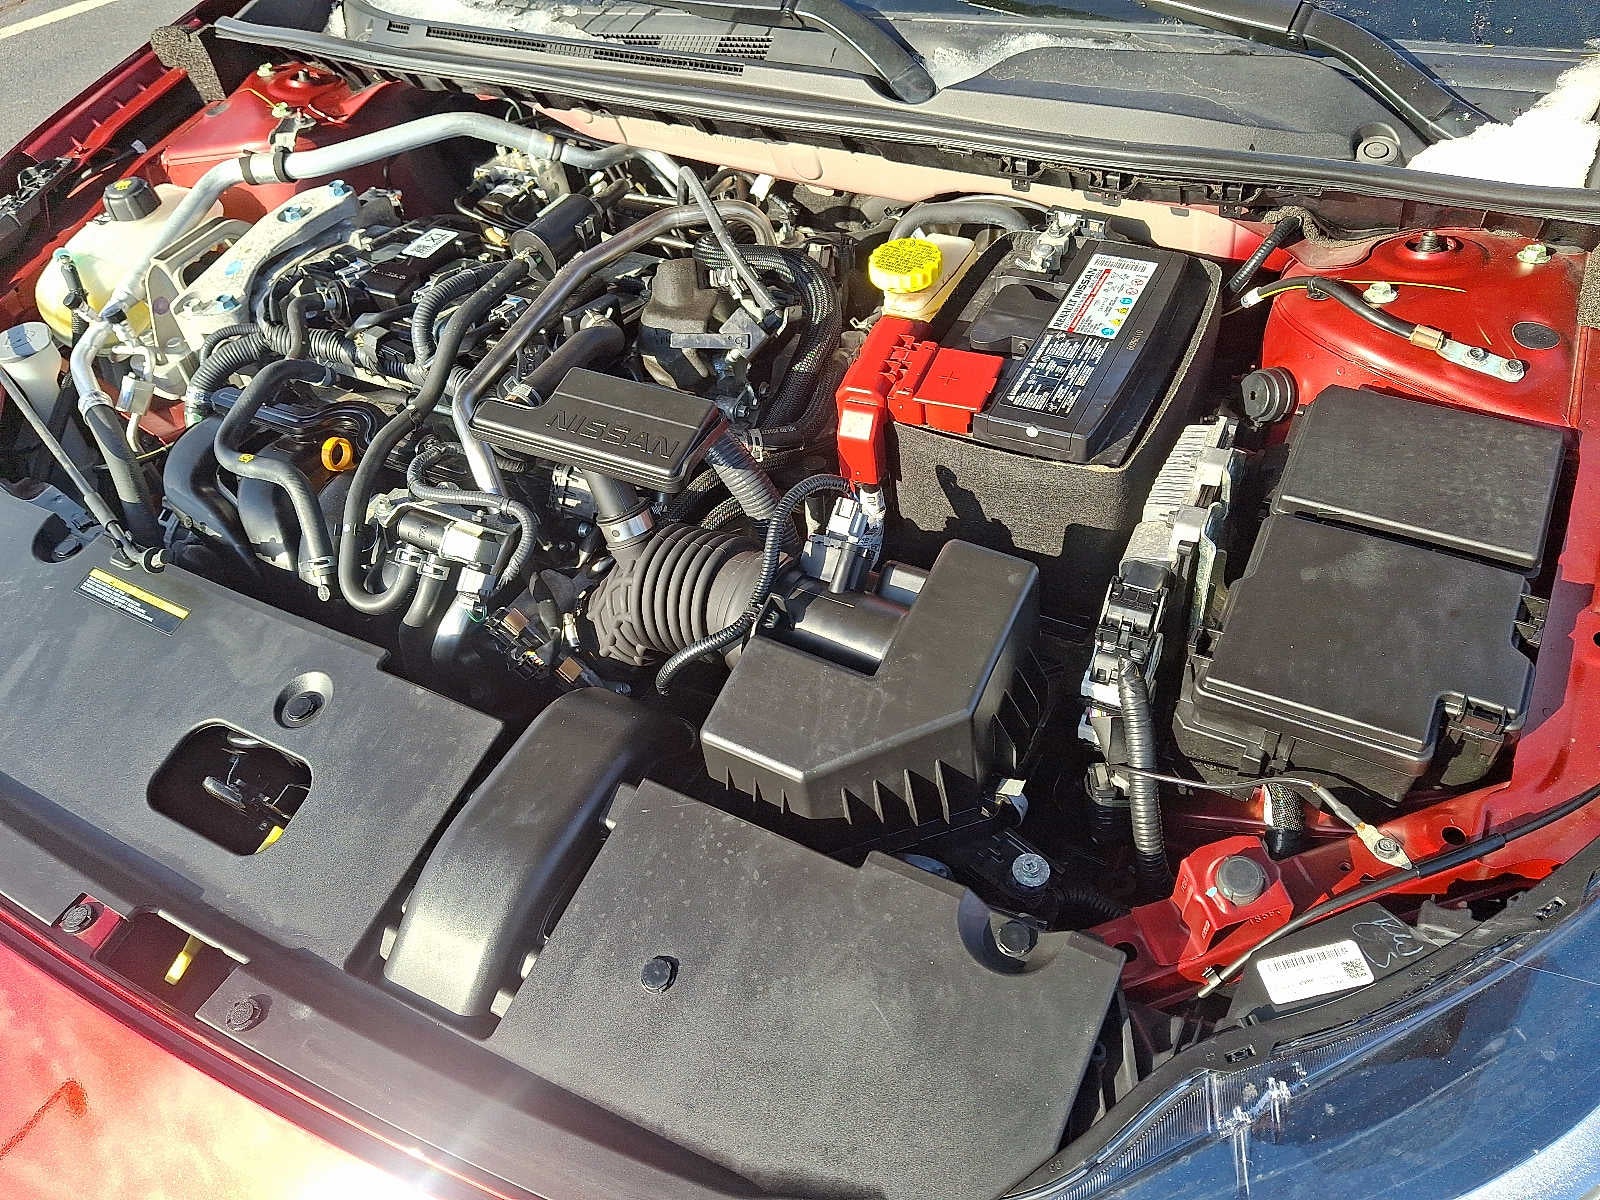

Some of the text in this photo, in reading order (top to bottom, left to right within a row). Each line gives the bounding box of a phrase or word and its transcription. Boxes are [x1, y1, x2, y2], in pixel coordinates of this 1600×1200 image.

[1052, 267, 1098, 328] RENAULT NISSAN
[546, 409, 680, 459] NISSAN
